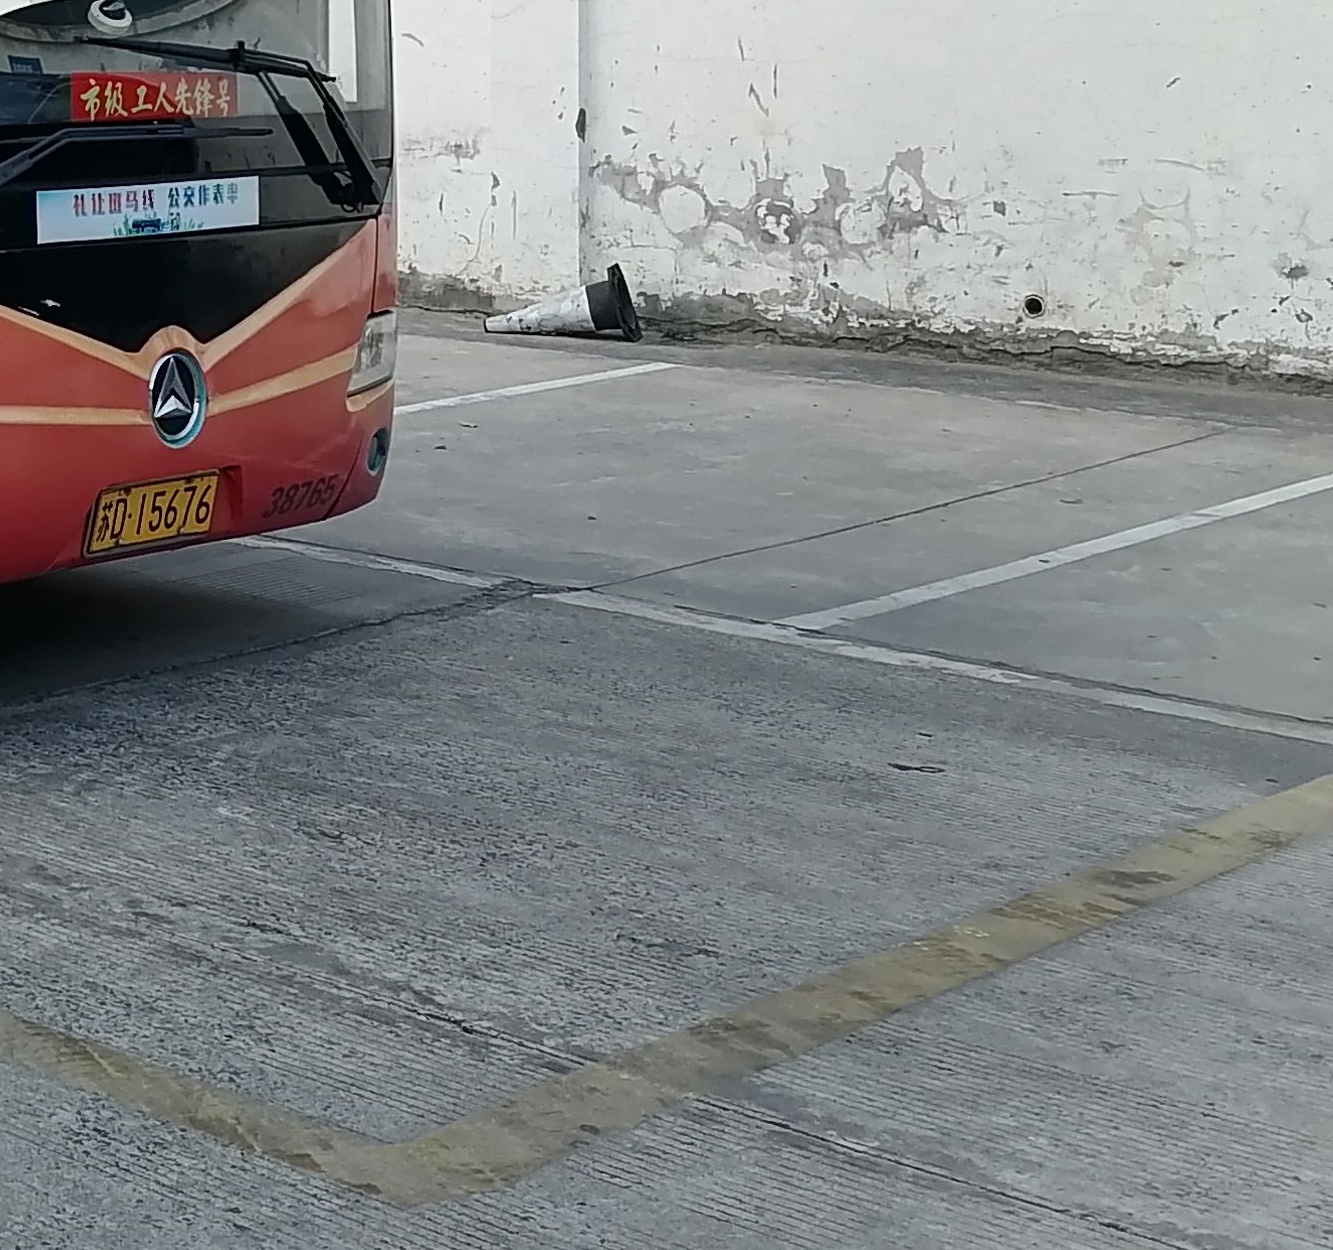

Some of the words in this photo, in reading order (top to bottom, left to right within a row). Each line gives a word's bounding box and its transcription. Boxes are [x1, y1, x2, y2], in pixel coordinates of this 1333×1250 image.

[79, 76, 231, 122] 市级工人先锋号
[262, 473, 342, 518] 38765
